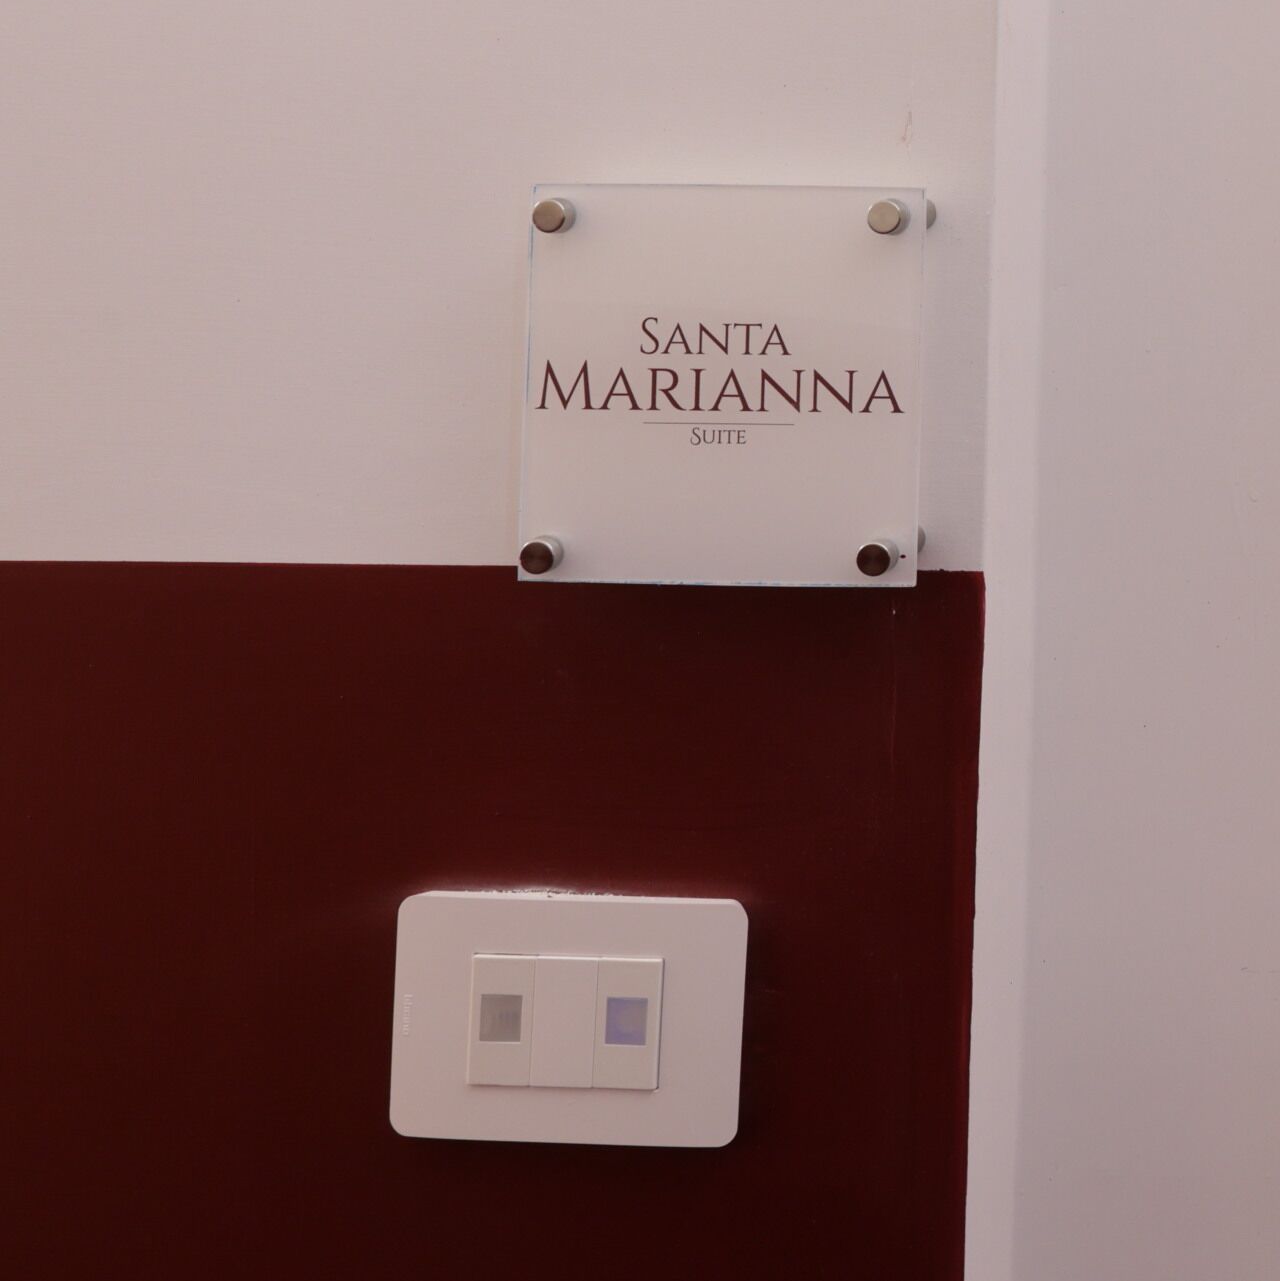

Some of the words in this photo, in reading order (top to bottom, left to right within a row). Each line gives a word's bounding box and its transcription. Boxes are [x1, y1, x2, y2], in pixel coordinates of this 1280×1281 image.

[639, 316, 792, 356] SANTA
[535, 359, 905, 414] MARIANNA
[689, 427, 747, 446] SUITE
